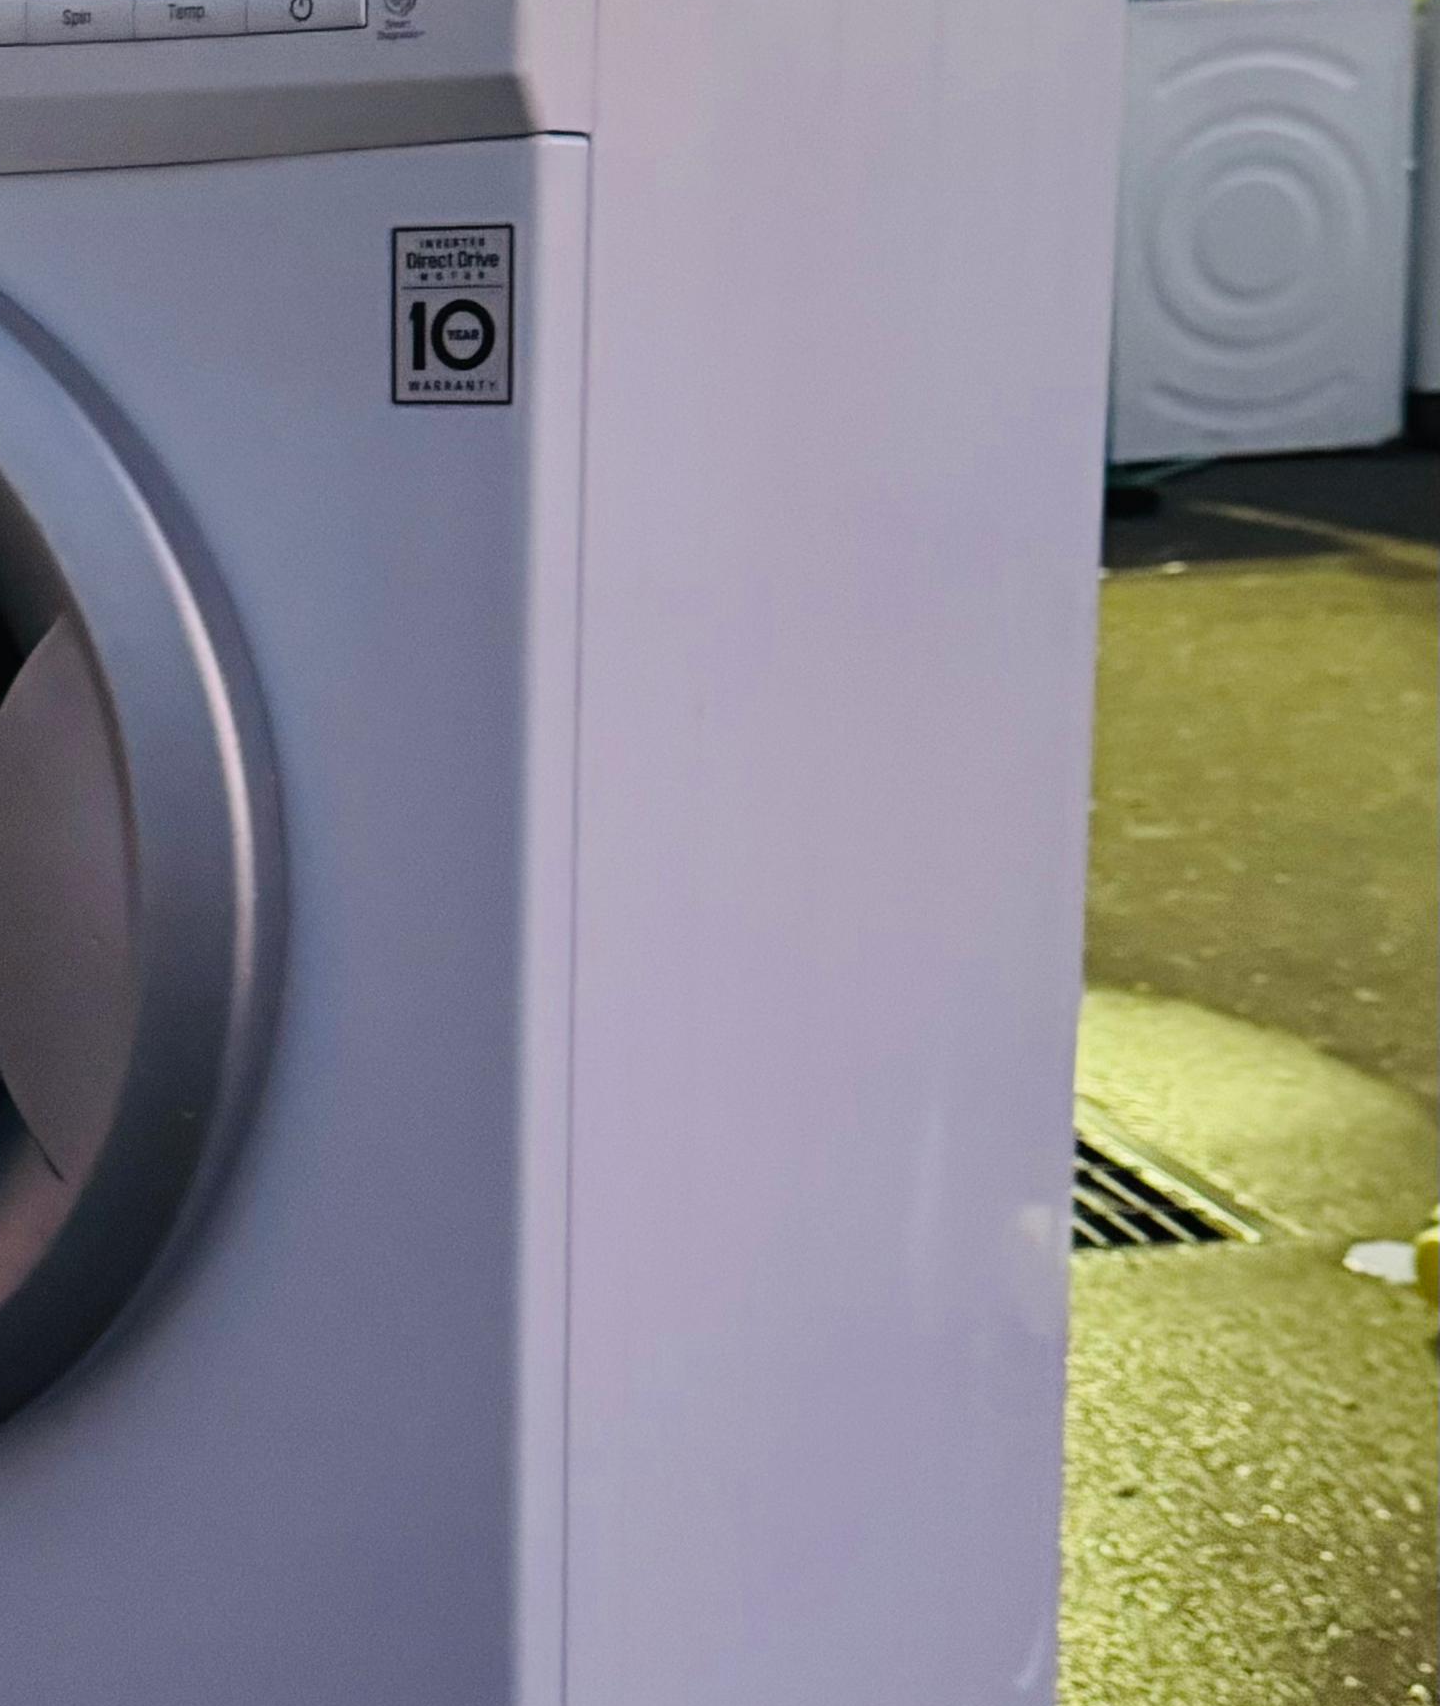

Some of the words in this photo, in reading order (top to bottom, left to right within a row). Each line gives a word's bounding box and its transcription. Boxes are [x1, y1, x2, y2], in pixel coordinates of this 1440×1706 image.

[62, 7, 92, 28] Spin
[406, 252, 454, 270] Direct
[458, 251, 500, 269] Drive
[409, 298, 496, 372] 10
[446, 328, 481, 341] YEAR
[408, 380, 498, 392] WARRANTY
